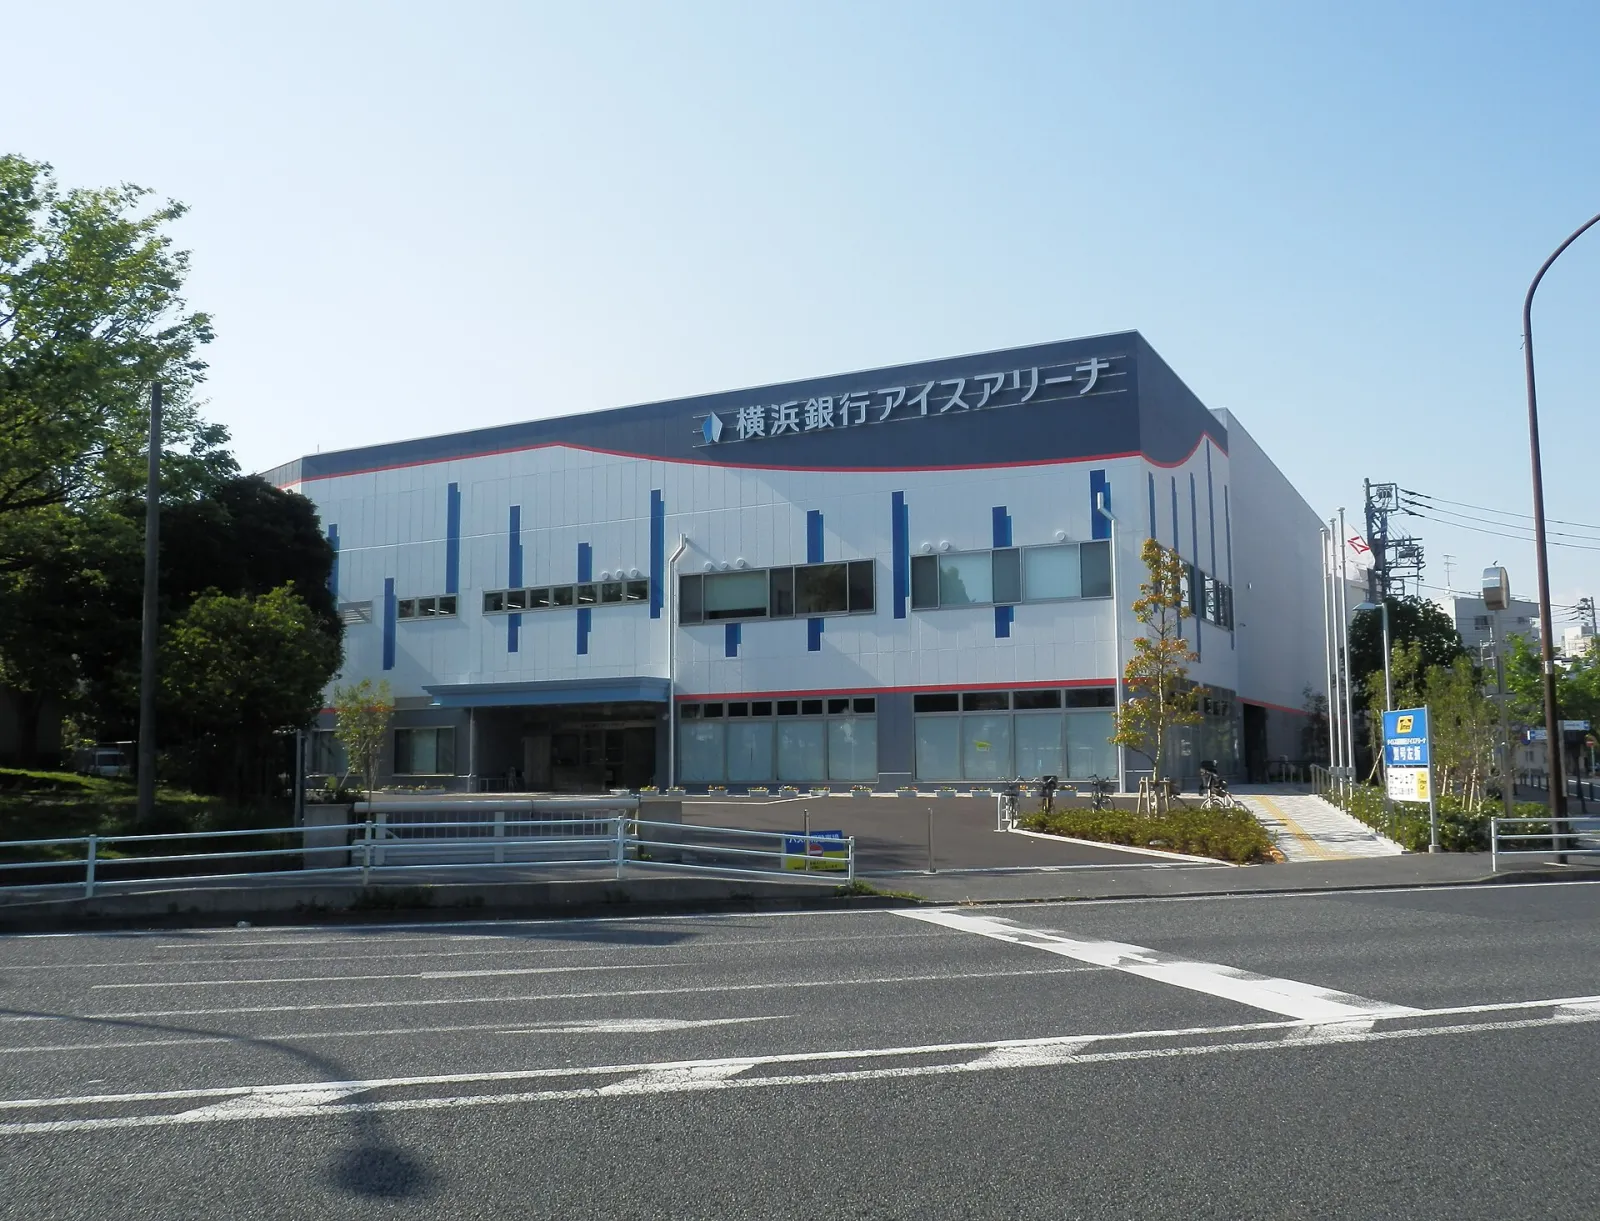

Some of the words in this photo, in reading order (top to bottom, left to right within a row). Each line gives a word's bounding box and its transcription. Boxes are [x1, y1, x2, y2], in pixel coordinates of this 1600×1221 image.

[736, 357, 1109, 439] 横浜銀行アイスアリーナ
